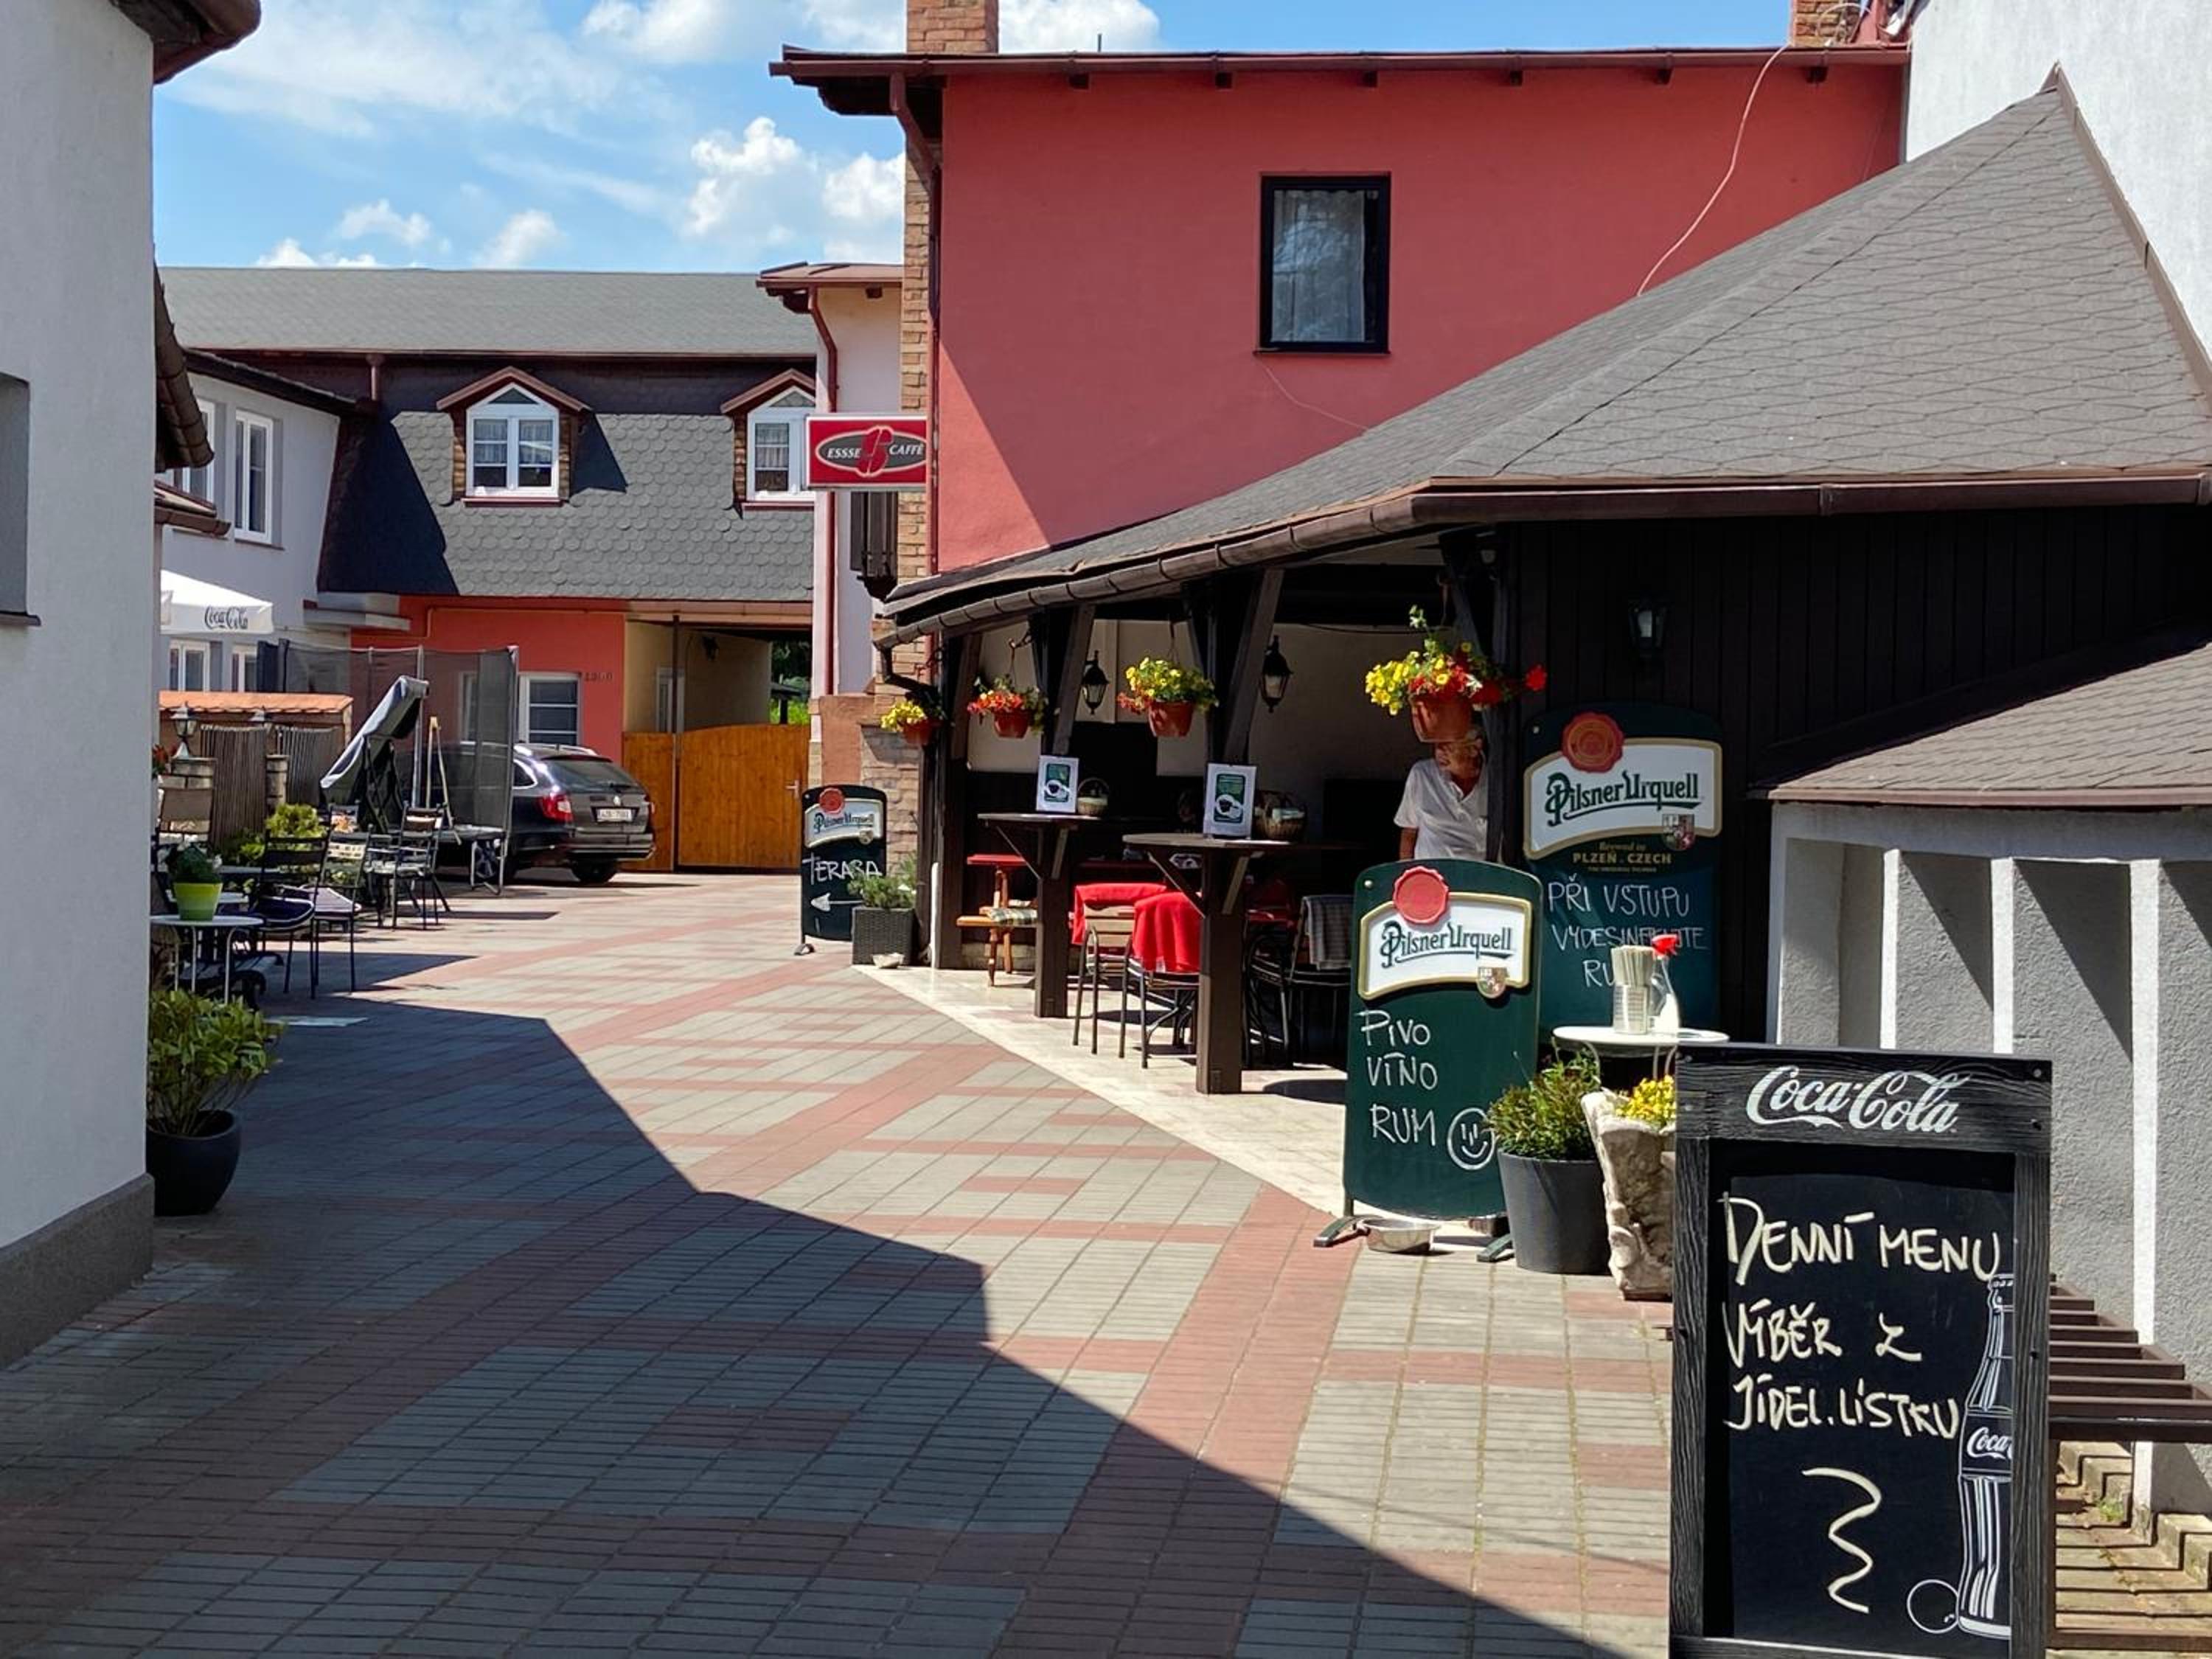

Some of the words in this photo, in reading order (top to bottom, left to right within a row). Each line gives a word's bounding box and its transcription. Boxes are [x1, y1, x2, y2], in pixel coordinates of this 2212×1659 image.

[827, 447, 862, 459] ESSSE
[1545, 771, 1624, 827] Pilsner
[1622, 770, 1699, 811] Urquell
[801, 852, 883, 886] TERASA
[1627, 852, 1672, 863] CZECH
[1548, 873, 1592, 913] PŘI
[1603, 884, 1689, 919] VSTUPU
[1380, 920, 1450, 968] Pilsner
[1447, 922, 1512, 960] Urquell
[1354, 1009, 1430, 1047] PIVO
[1366, 1051, 1438, 1091] VÍNO
[1745, 1065, 1972, 1134] Coca-Cola
[1368, 1103, 1436, 1147] RUM
[1717, 1191, 1875, 1285] DENNÍ
[1878, 1224, 2000, 1281] MENU
